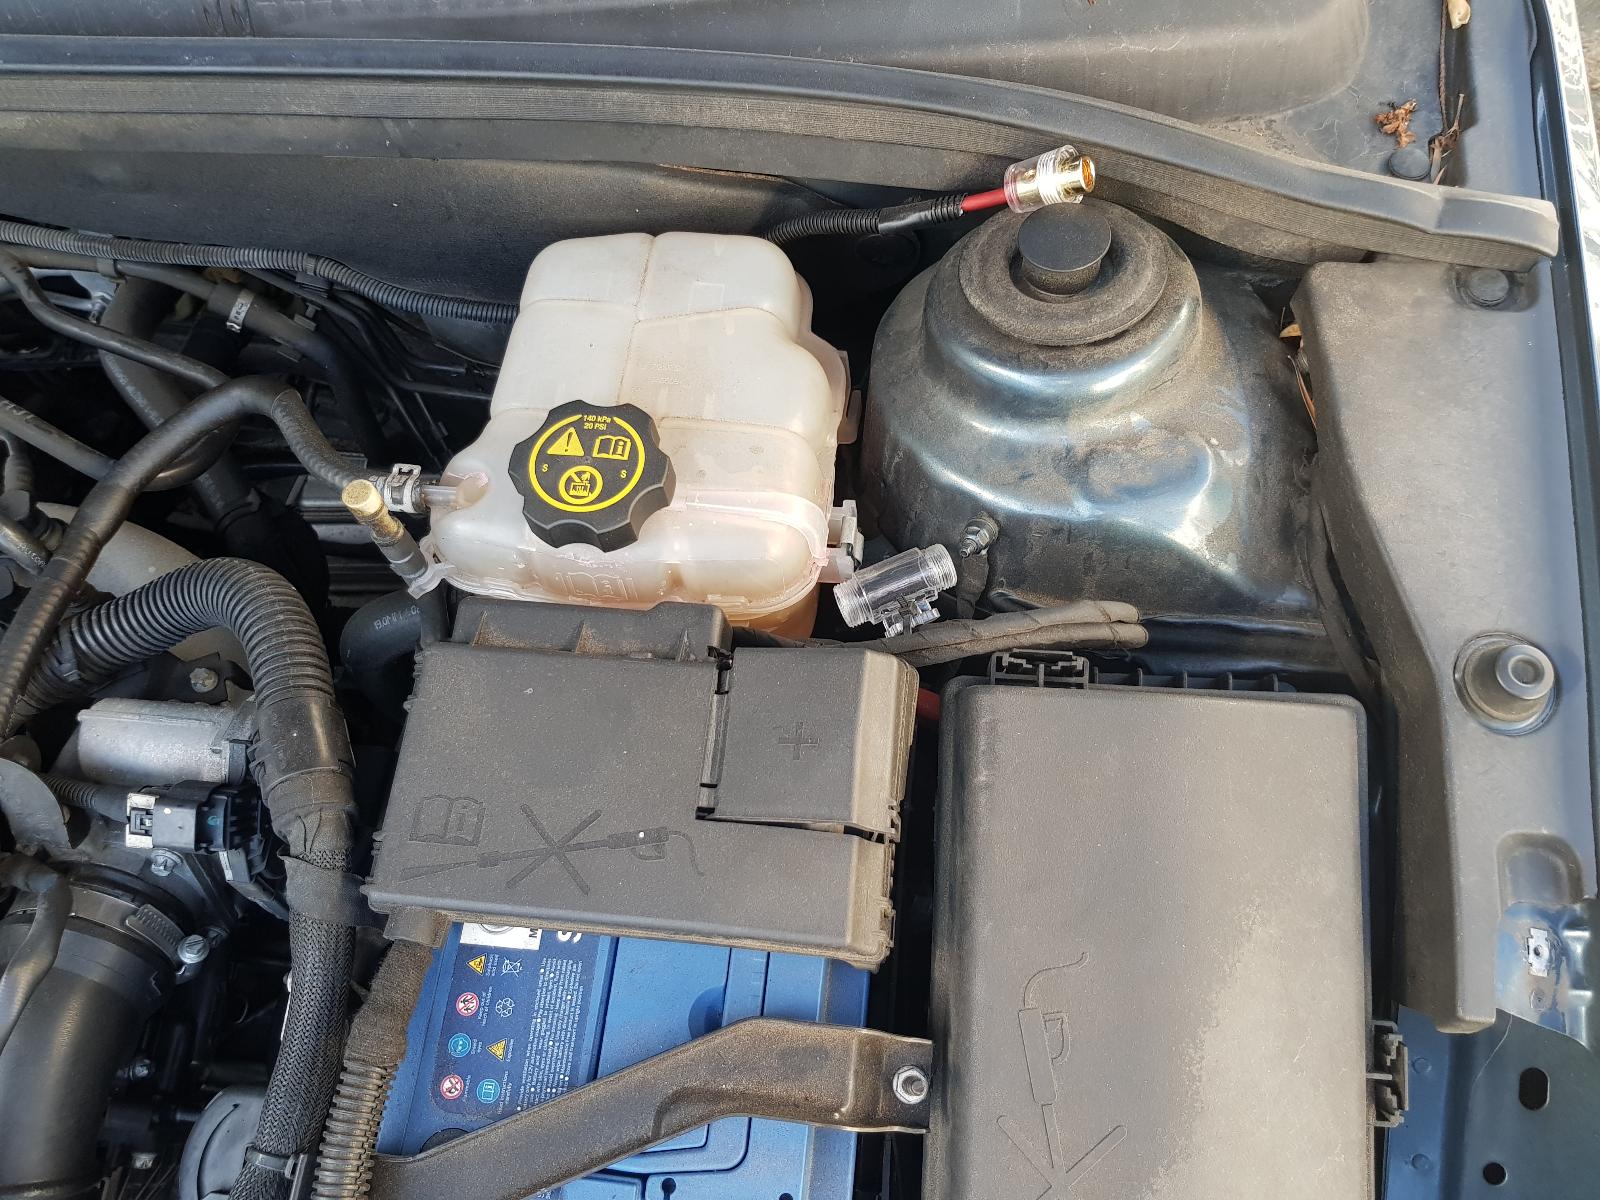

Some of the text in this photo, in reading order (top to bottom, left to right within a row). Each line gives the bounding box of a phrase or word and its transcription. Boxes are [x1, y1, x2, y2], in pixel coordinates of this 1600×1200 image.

[594, 423, 607, 431] PSI
[542, 463, 549, 472] S
[620, 469, 627, 479] S
